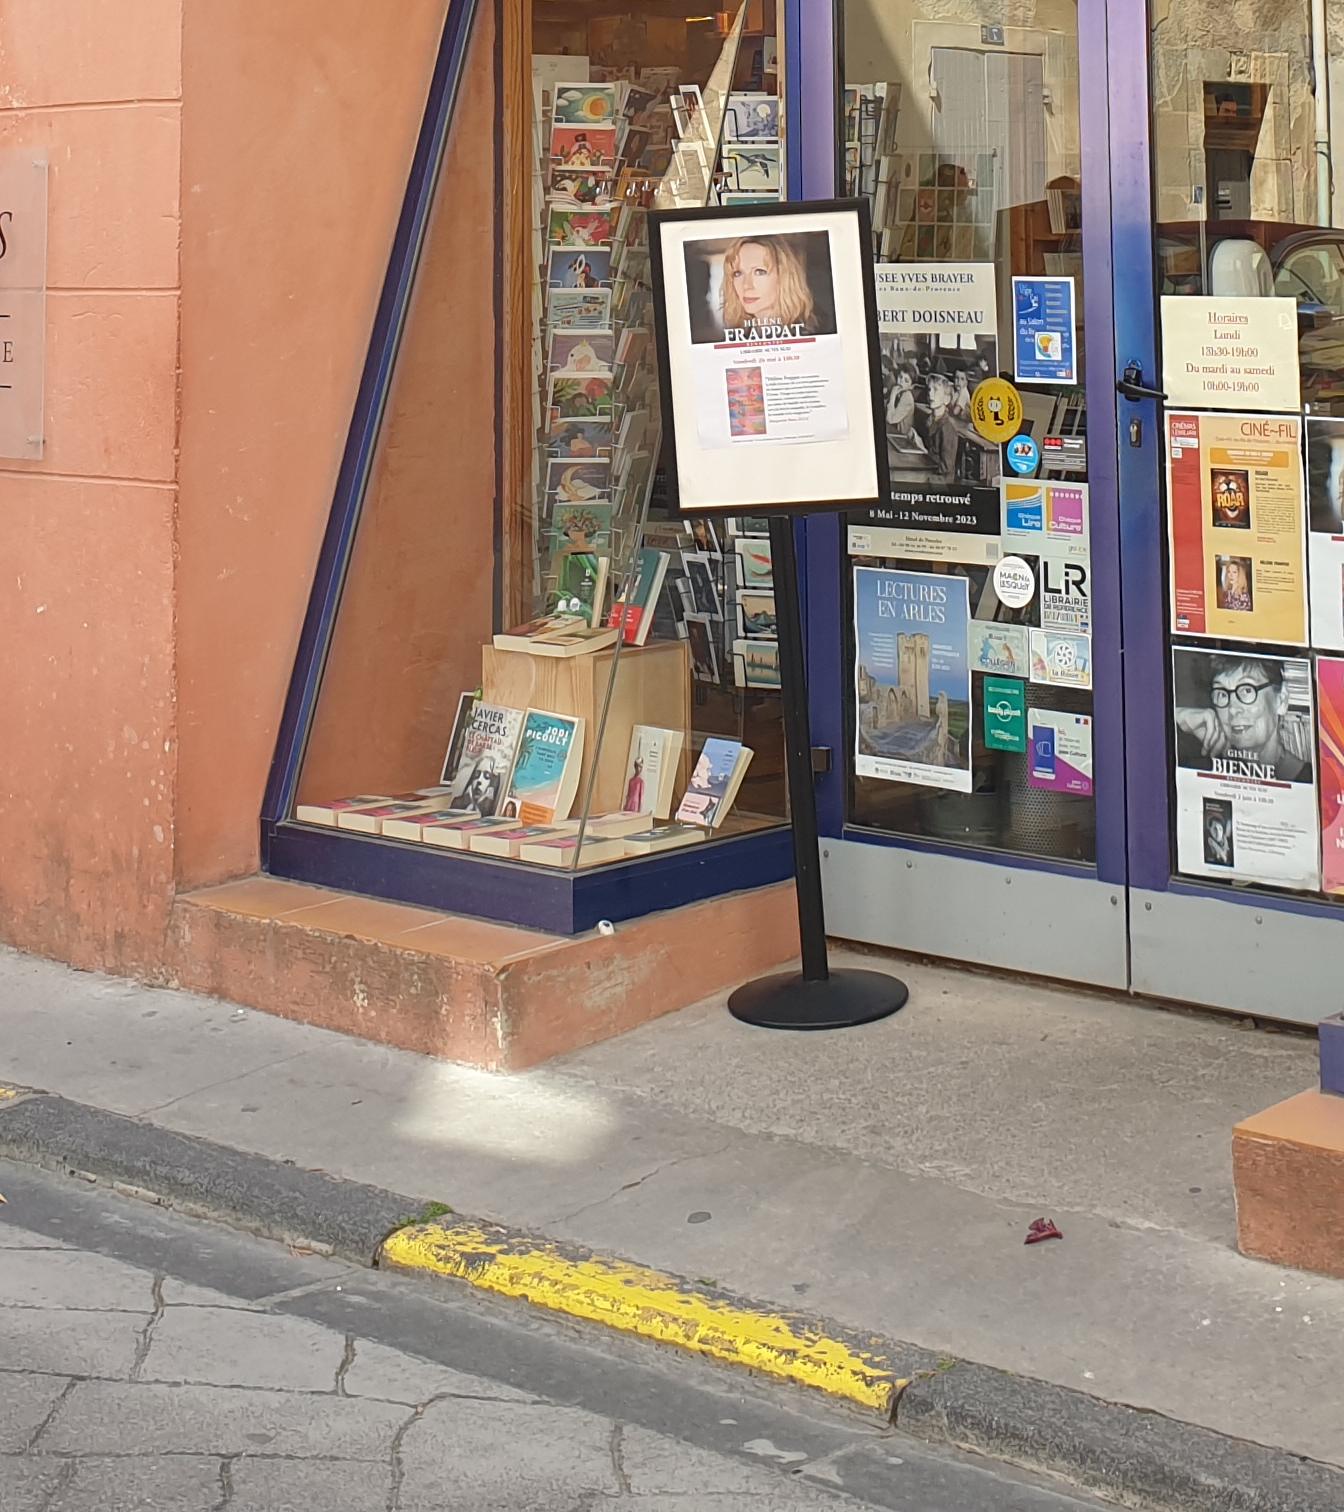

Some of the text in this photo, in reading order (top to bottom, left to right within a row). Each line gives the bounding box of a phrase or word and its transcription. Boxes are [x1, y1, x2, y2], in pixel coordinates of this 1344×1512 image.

[875, 272, 974, 284] SEE YVES BRAYER
[912, 309, 984, 324] DOISNEAU
[1207, 311, 1249, 324] Horaires
[724, 323, 805, 343] FRAPPAT
[1213, 329, 1241, 340] Lundi
[1185, 362, 1200, 374] Du
[1202, 364, 1228, 374] mardi
[1243, 364, 1275, 376] samedi
[1201, 379, 1260, 393] 10h00-19h00
[891, 491, 971, 506] temps retrouvé
[1216, 494, 1245, 508] ROAR
[877, 509, 893, 520] Mai
[911, 511, 954, 524] Novembre
[955, 514, 977, 525] 2023
[876, 579, 948, 604] LECTURES
[878, 600, 946, 624] EN ARLES
[474, 708, 504, 724] JAVIER
[471, 719, 507, 737] CERCAS
[545, 726, 569, 738] JODI
[526, 729, 568, 746] PICOULT
[1227, 747, 1260, 761] GISÈLE
[1212, 757, 1277, 781] BIENNE
